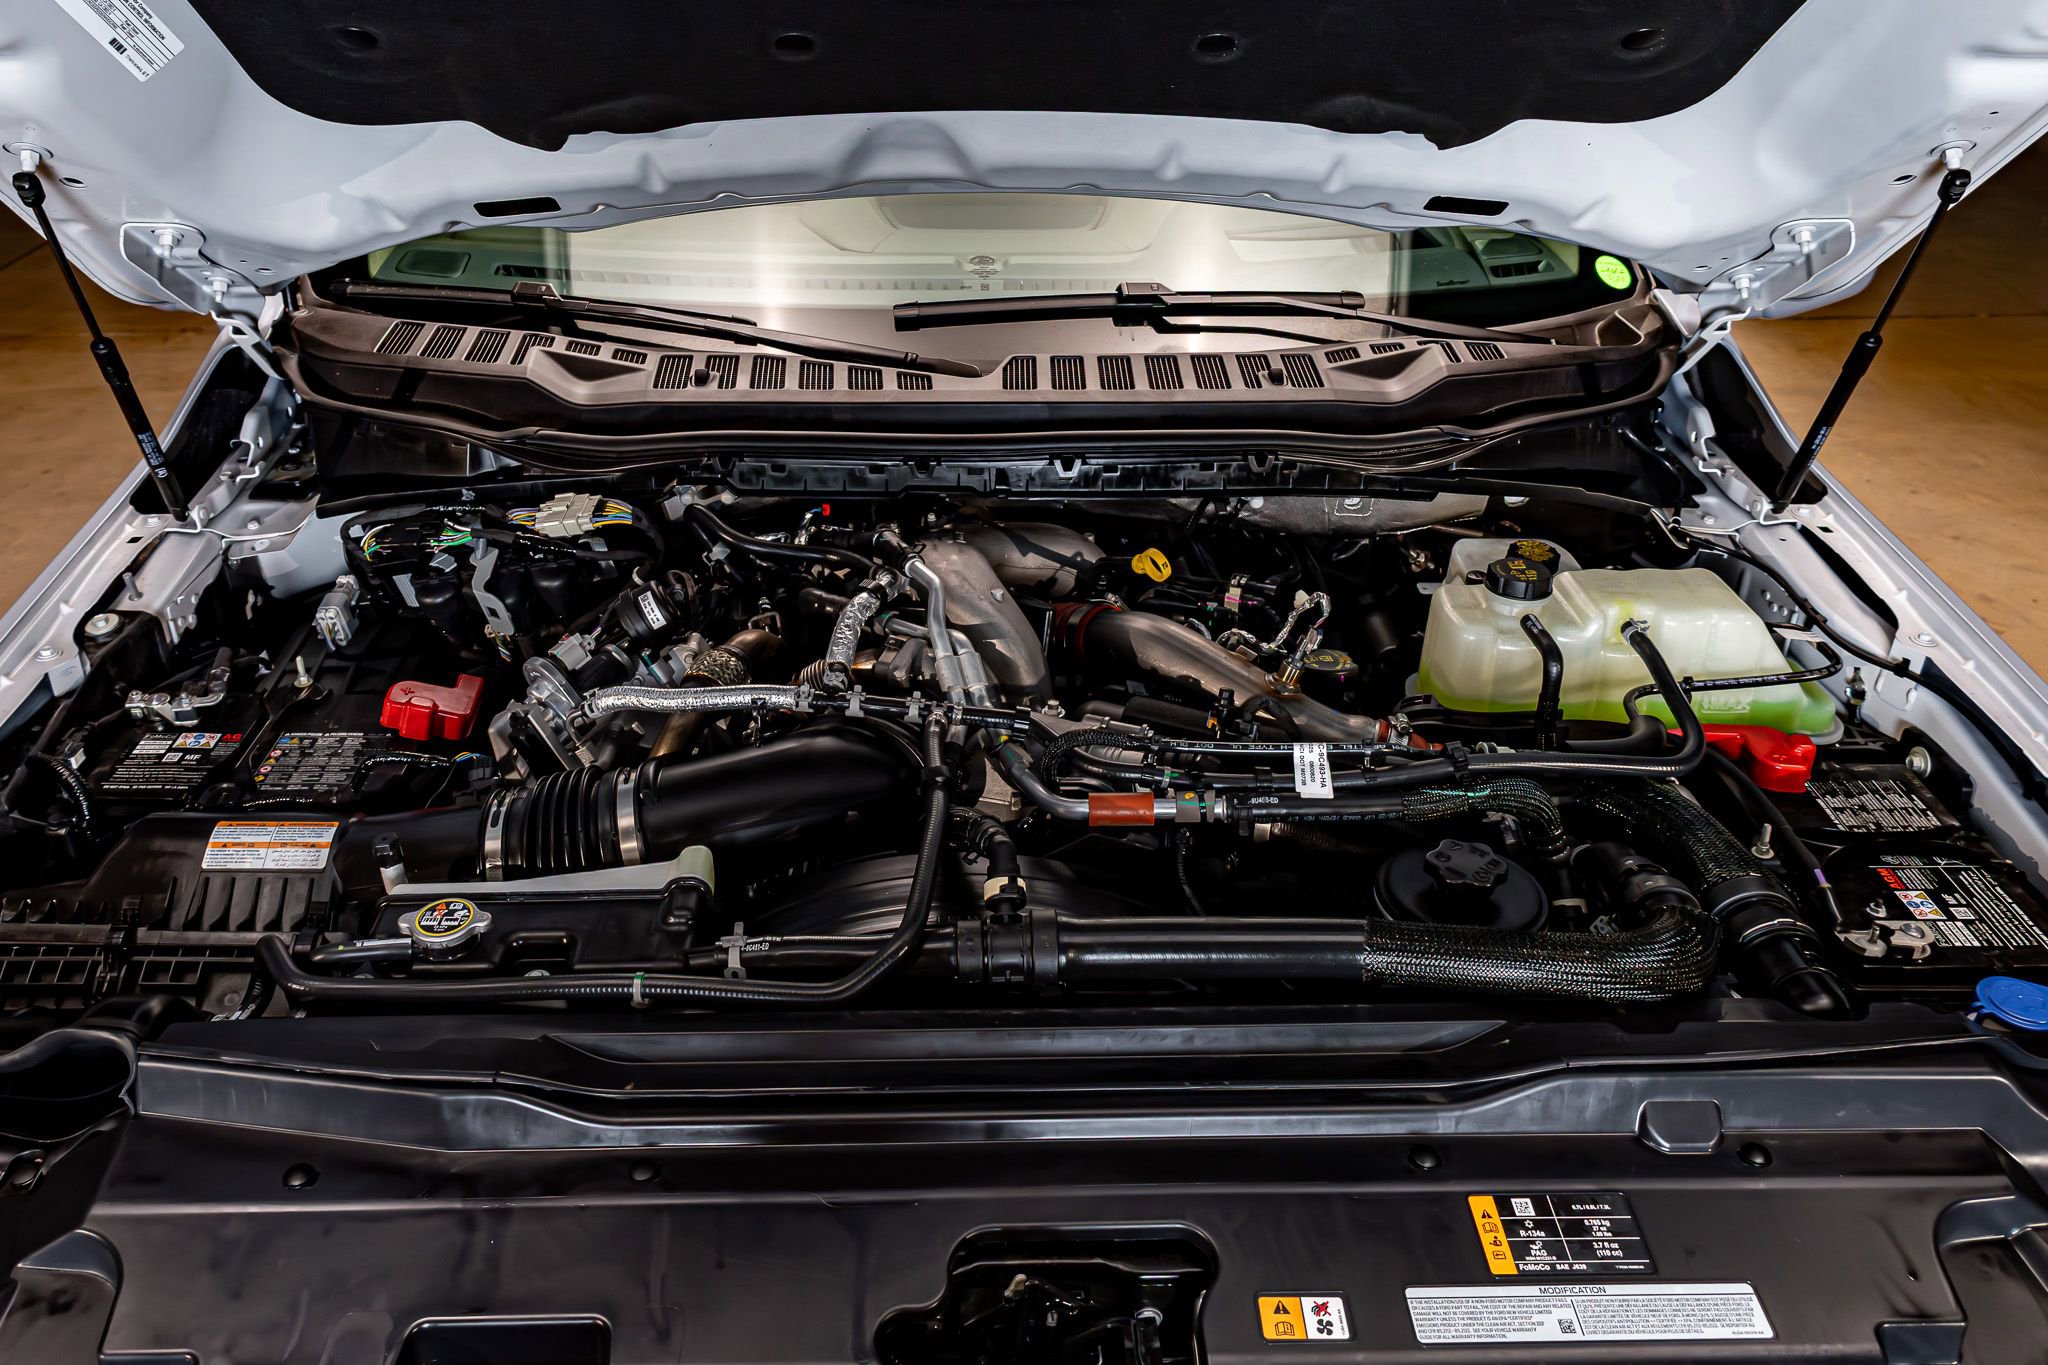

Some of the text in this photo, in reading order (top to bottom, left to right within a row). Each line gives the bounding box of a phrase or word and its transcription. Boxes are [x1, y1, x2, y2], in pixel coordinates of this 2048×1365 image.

[128, 2, 144, 19] CONTROL
[143, 18, 166, 40] INFORMATION
[1876, 868, 1902, 889] AGM
[1539, 1286, 1606, 1295] MODIFICATION
